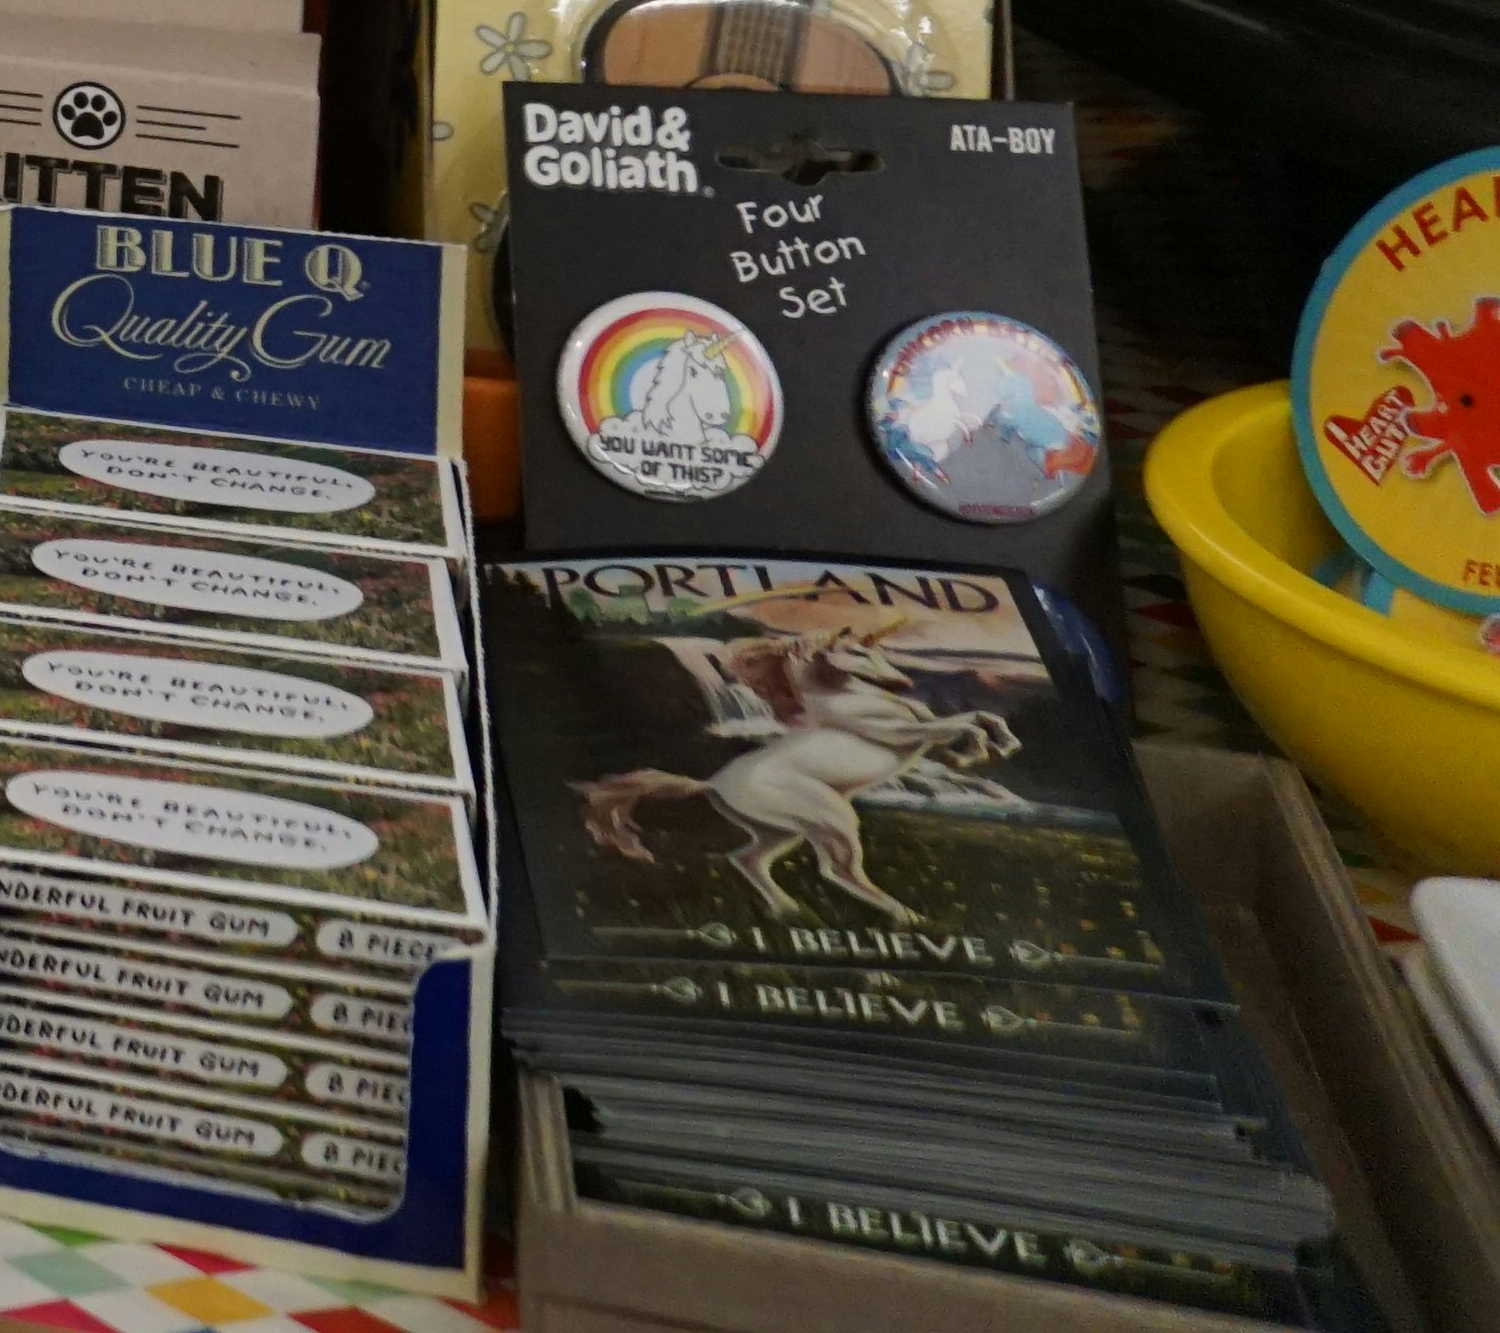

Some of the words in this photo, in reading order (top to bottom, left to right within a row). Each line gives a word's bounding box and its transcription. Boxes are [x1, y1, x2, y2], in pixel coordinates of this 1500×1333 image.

[949, 125, 1057, 158] ATA-BOY
[524, 145, 700, 194] Goliath
[736, 193, 825, 236] Four
[729, 233, 867, 285] Button
[778, 276, 849, 321] Set
[122, 376, 202, 396] CHEAP
[211, 385, 227, 400] &
[235, 390, 322, 411] CHEWY
[79, 448, 173, 468] YOU'RE
[599, 434, 638, 457] YOU
[640, 439, 696, 461] WANT
[701, 444, 760, 473] SOME
[640, 460, 665, 481] OF
[668, 461, 724, 485] THIS?
[106, 465, 199, 484] DON'T
[210, 476, 333, 502] CHANGE.
[540, 562, 1001, 618] PORTLAND
[121, 898, 196, 927] FRUIT
[208, 911, 273, 939] GUM
[751, 924, 764, 951] I
[788, 925, 995, 969] BELIEVE
[116, 968, 192, 997] FRUIT
[203, 982, 266, 1011] GUM
[717, 980, 732, 1010] I
[755, 983, 964, 1032] BELIEVE
